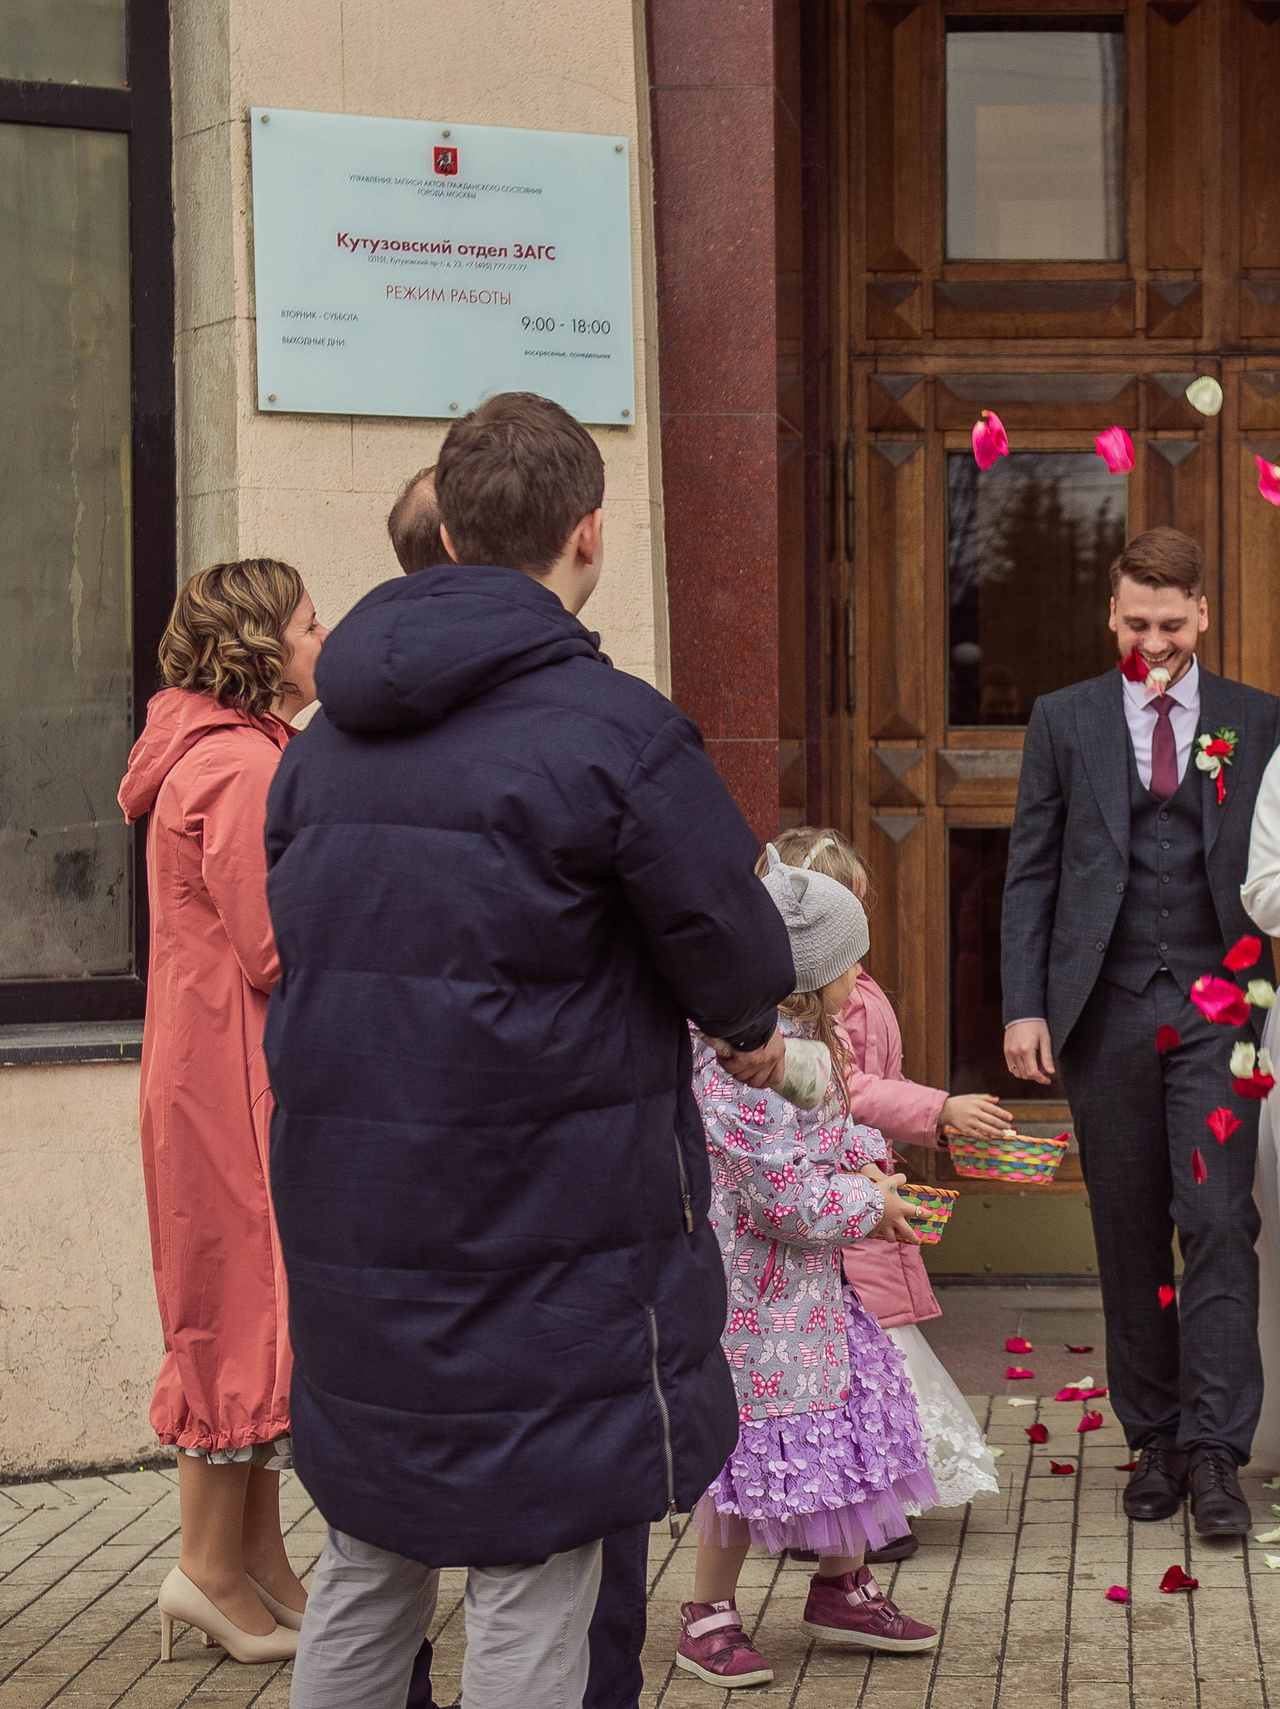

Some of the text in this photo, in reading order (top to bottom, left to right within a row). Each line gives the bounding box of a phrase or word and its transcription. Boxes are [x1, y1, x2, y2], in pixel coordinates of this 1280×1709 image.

[337, 232, 556, 261] Кутузовский отдел ЗАГС
[386, 284, 512, 306] РЕЖИМ РАБОТЫ
[281, 309, 317, 319] ВТОРНИК
[323, 311, 359, 322] СУББОТА
[521, 315, 556, 332] 9:00
[571, 318, 611, 335] 18:00
[281, 335, 326, 347] ВЫХОДНЫЕ
